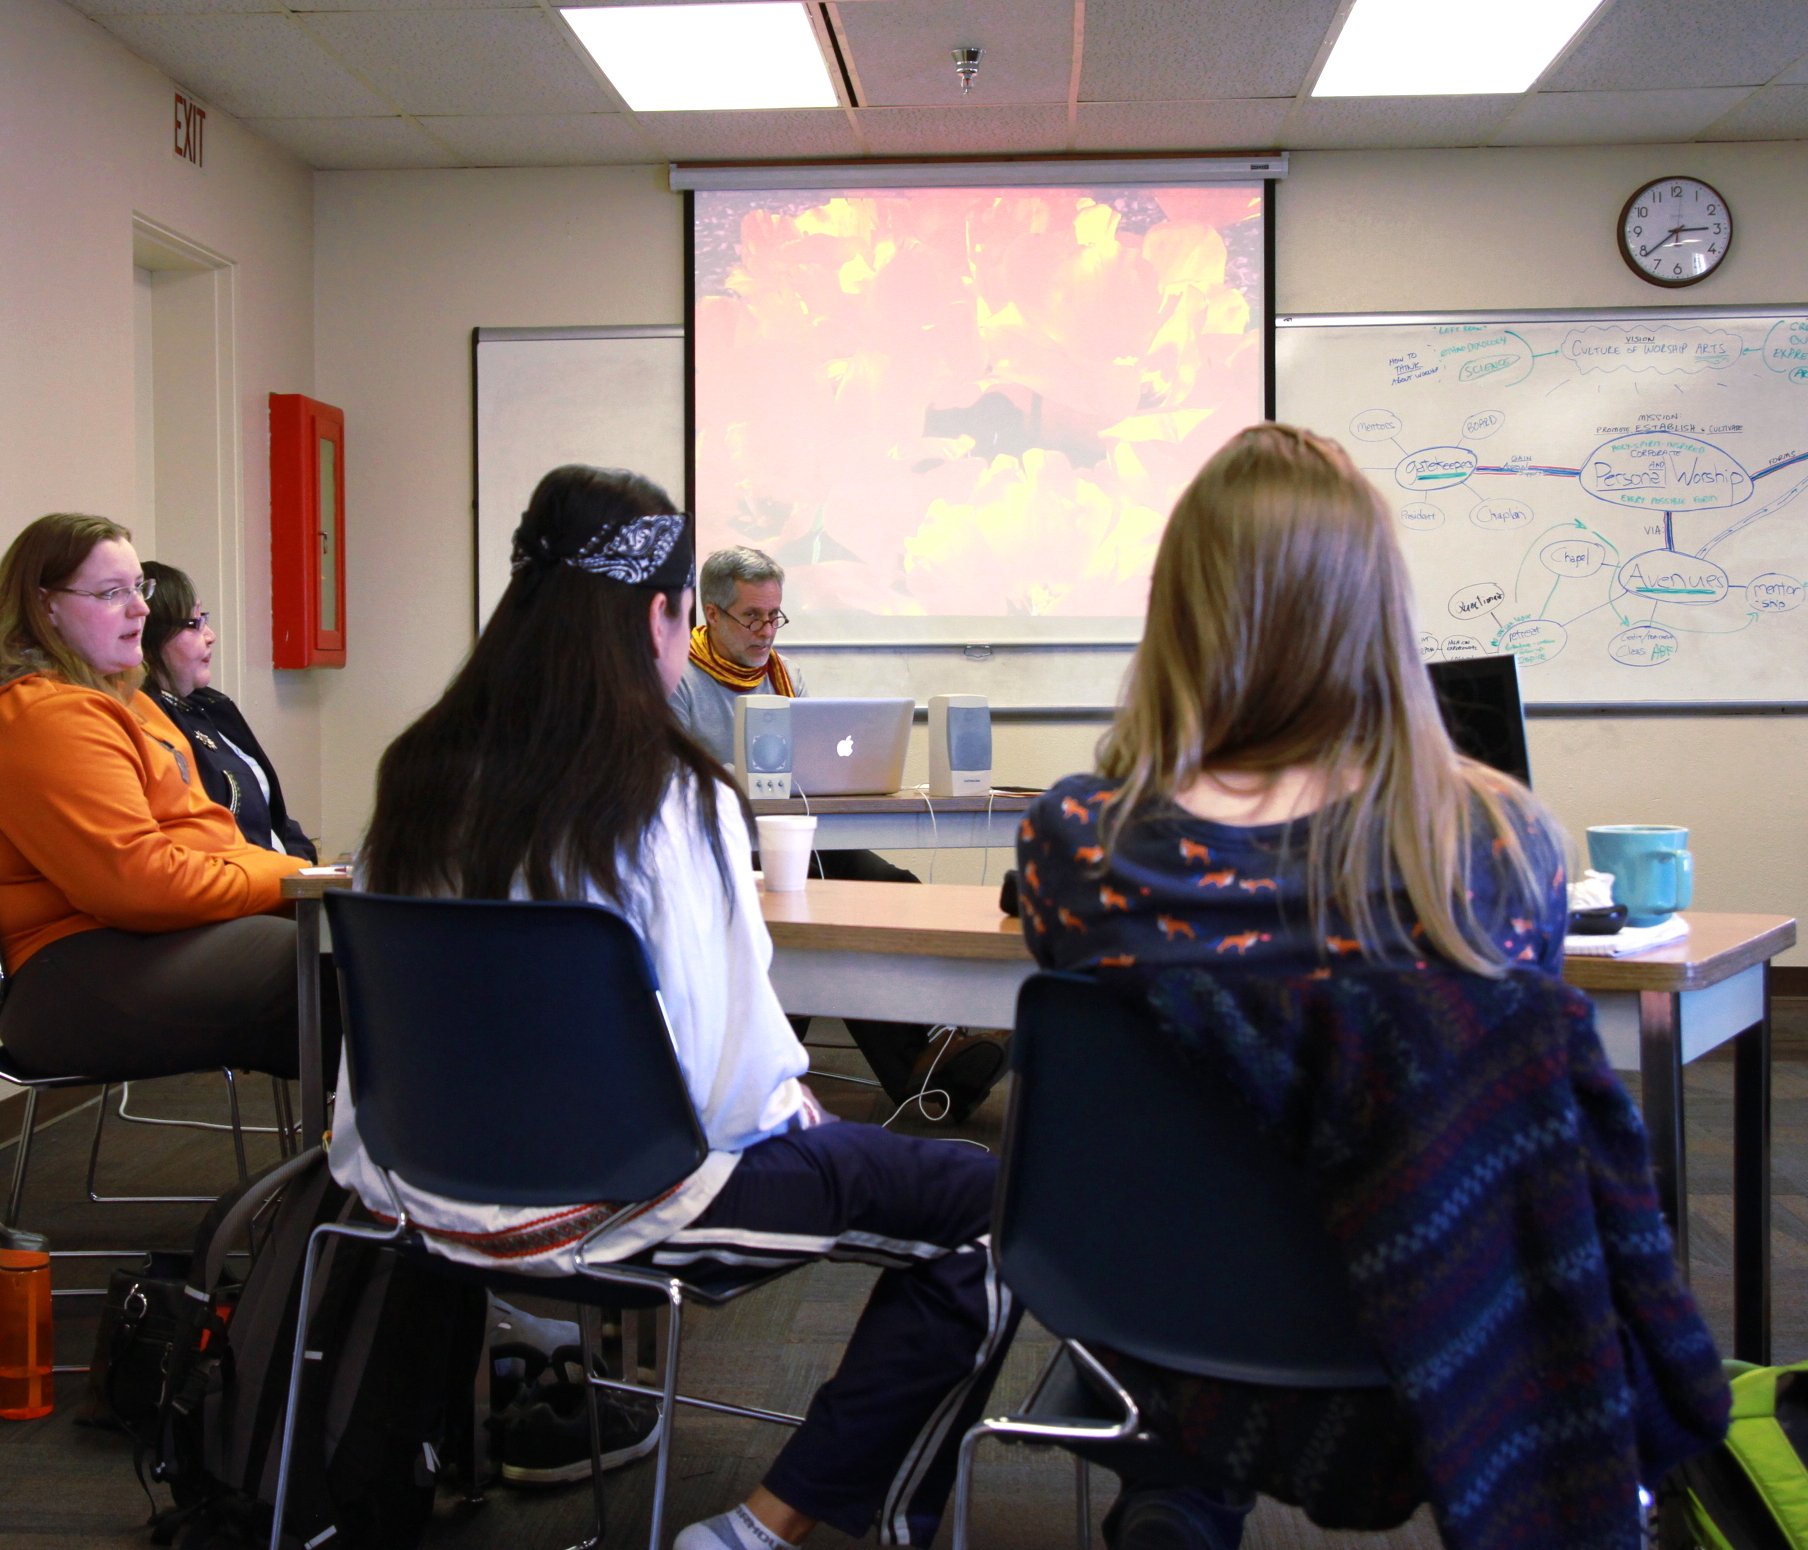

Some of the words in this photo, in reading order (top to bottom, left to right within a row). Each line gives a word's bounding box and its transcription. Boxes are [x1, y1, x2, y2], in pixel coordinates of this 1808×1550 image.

[174, 92, 206, 168] EXIT
[1652, 191, 1661, 203] 11
[1671, 186, 1682, 198] 12
[1637, 207, 1648, 218] 10
[1706, 204, 1716, 215] 2
[1633, 225, 1642, 237] 9
[1713, 223, 1721, 235] 3
[1639, 245, 1648, 257] 8
[1707, 242, 1716, 254] 4
[1653, 259, 1662, 270] 7
[1673, 263, 1682, 275] 6
[1572, 340, 1620, 356] CULTURE
[1644, 343, 1688, 354] WORSHIP
[1695, 343, 1727, 354] ARTS
[1407, 352, 1417, 360] TO
[1395, 362, 1422, 374] THINK
[1464, 357, 1511, 378] SCIENCE
[1467, 415, 1498, 433] BOARD
[1635, 423, 1695, 432] ESTABLISH
[1630, 450, 1682, 459] CORPORATE
[1648, 460, 1666, 469] AND
[1594, 456, 1667, 488] Personal
[1669, 453, 1745, 505] Worship
[1551, 547, 1590, 568] Chapel
[1623, 564, 1724, 588] Avenues
[1753, 582, 1802, 598] mentor
